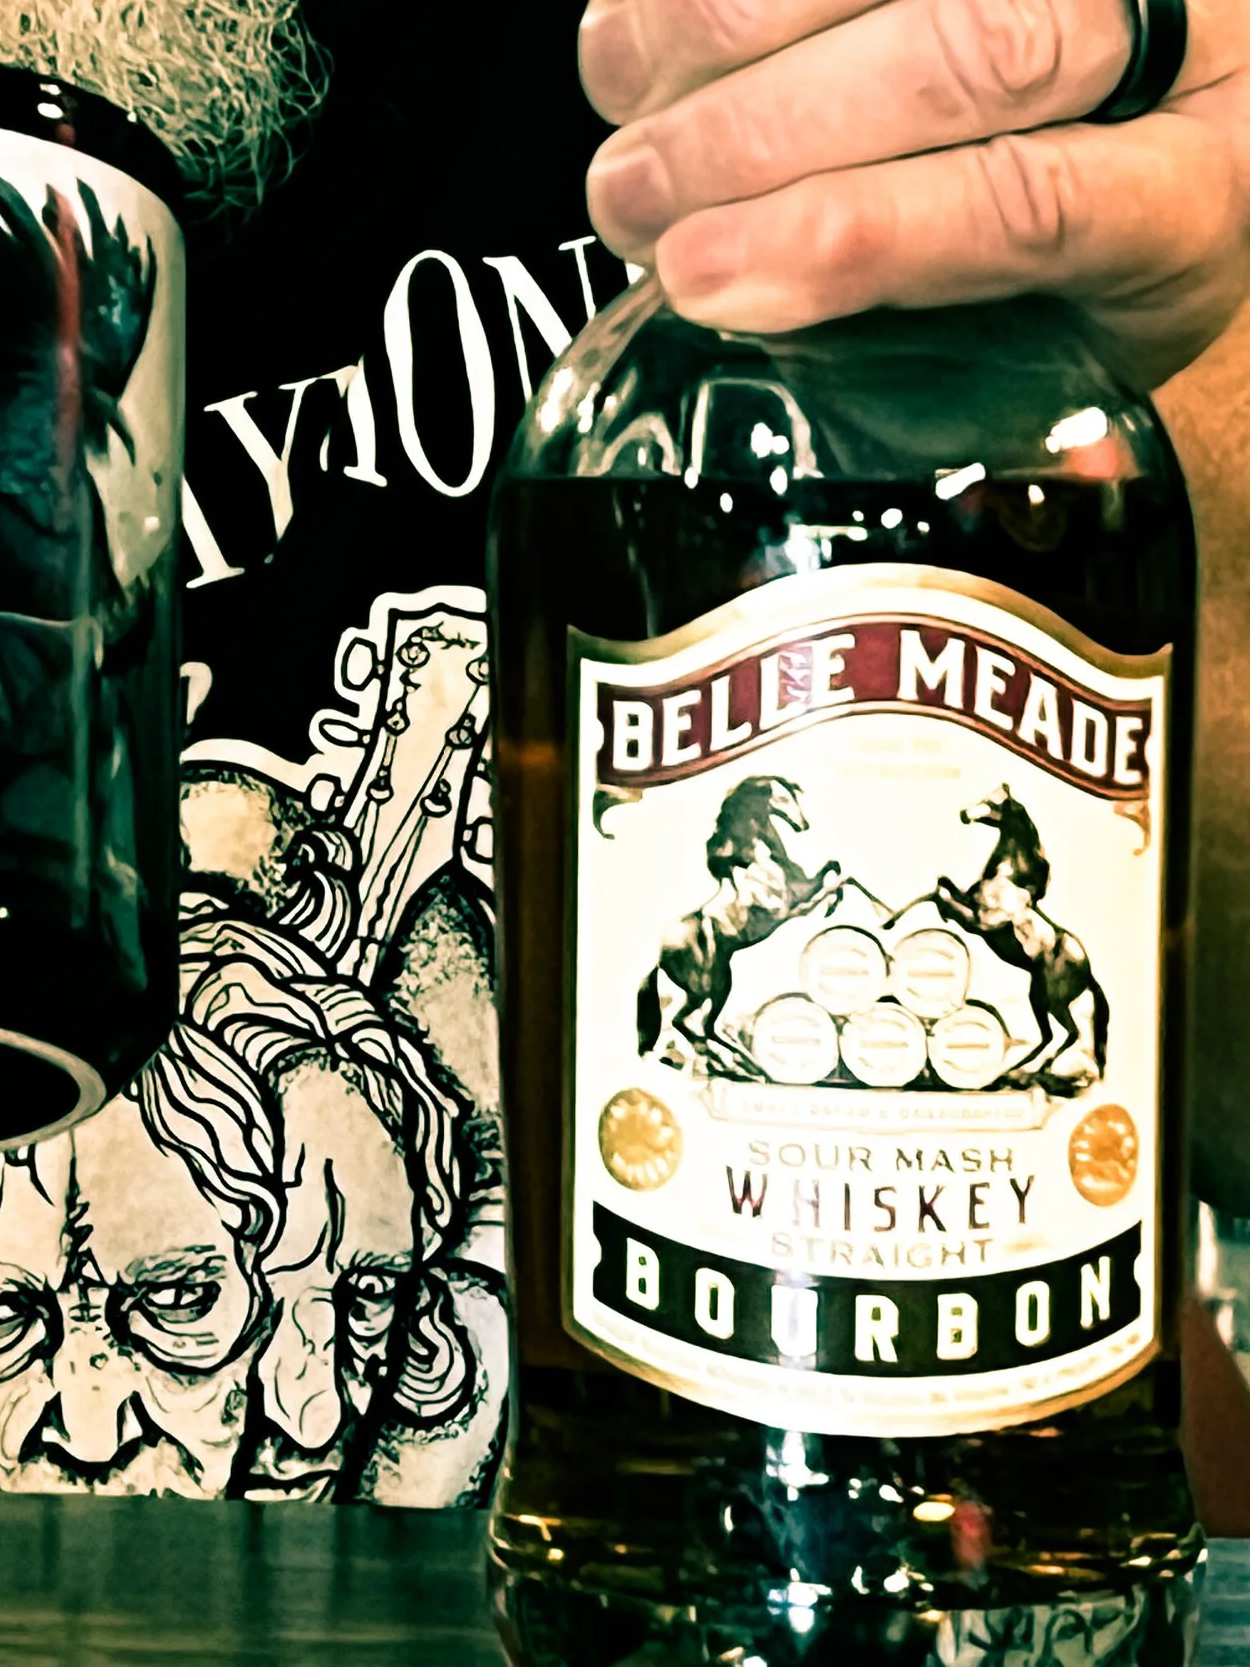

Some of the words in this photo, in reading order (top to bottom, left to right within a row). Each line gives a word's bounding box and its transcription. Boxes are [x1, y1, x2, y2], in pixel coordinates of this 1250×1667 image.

[611, 633, 856, 772] BELLE
[897, 629, 1147, 786] MEADE
[747, 1139, 874, 1172] SOUR
[895, 1147, 1015, 1174] MASH
[725, 1165, 1036, 1235] WHISKEY
[770, 1231, 995, 1270] STRAIGHT
[625, 1235, 1113, 1364] BOURBON
